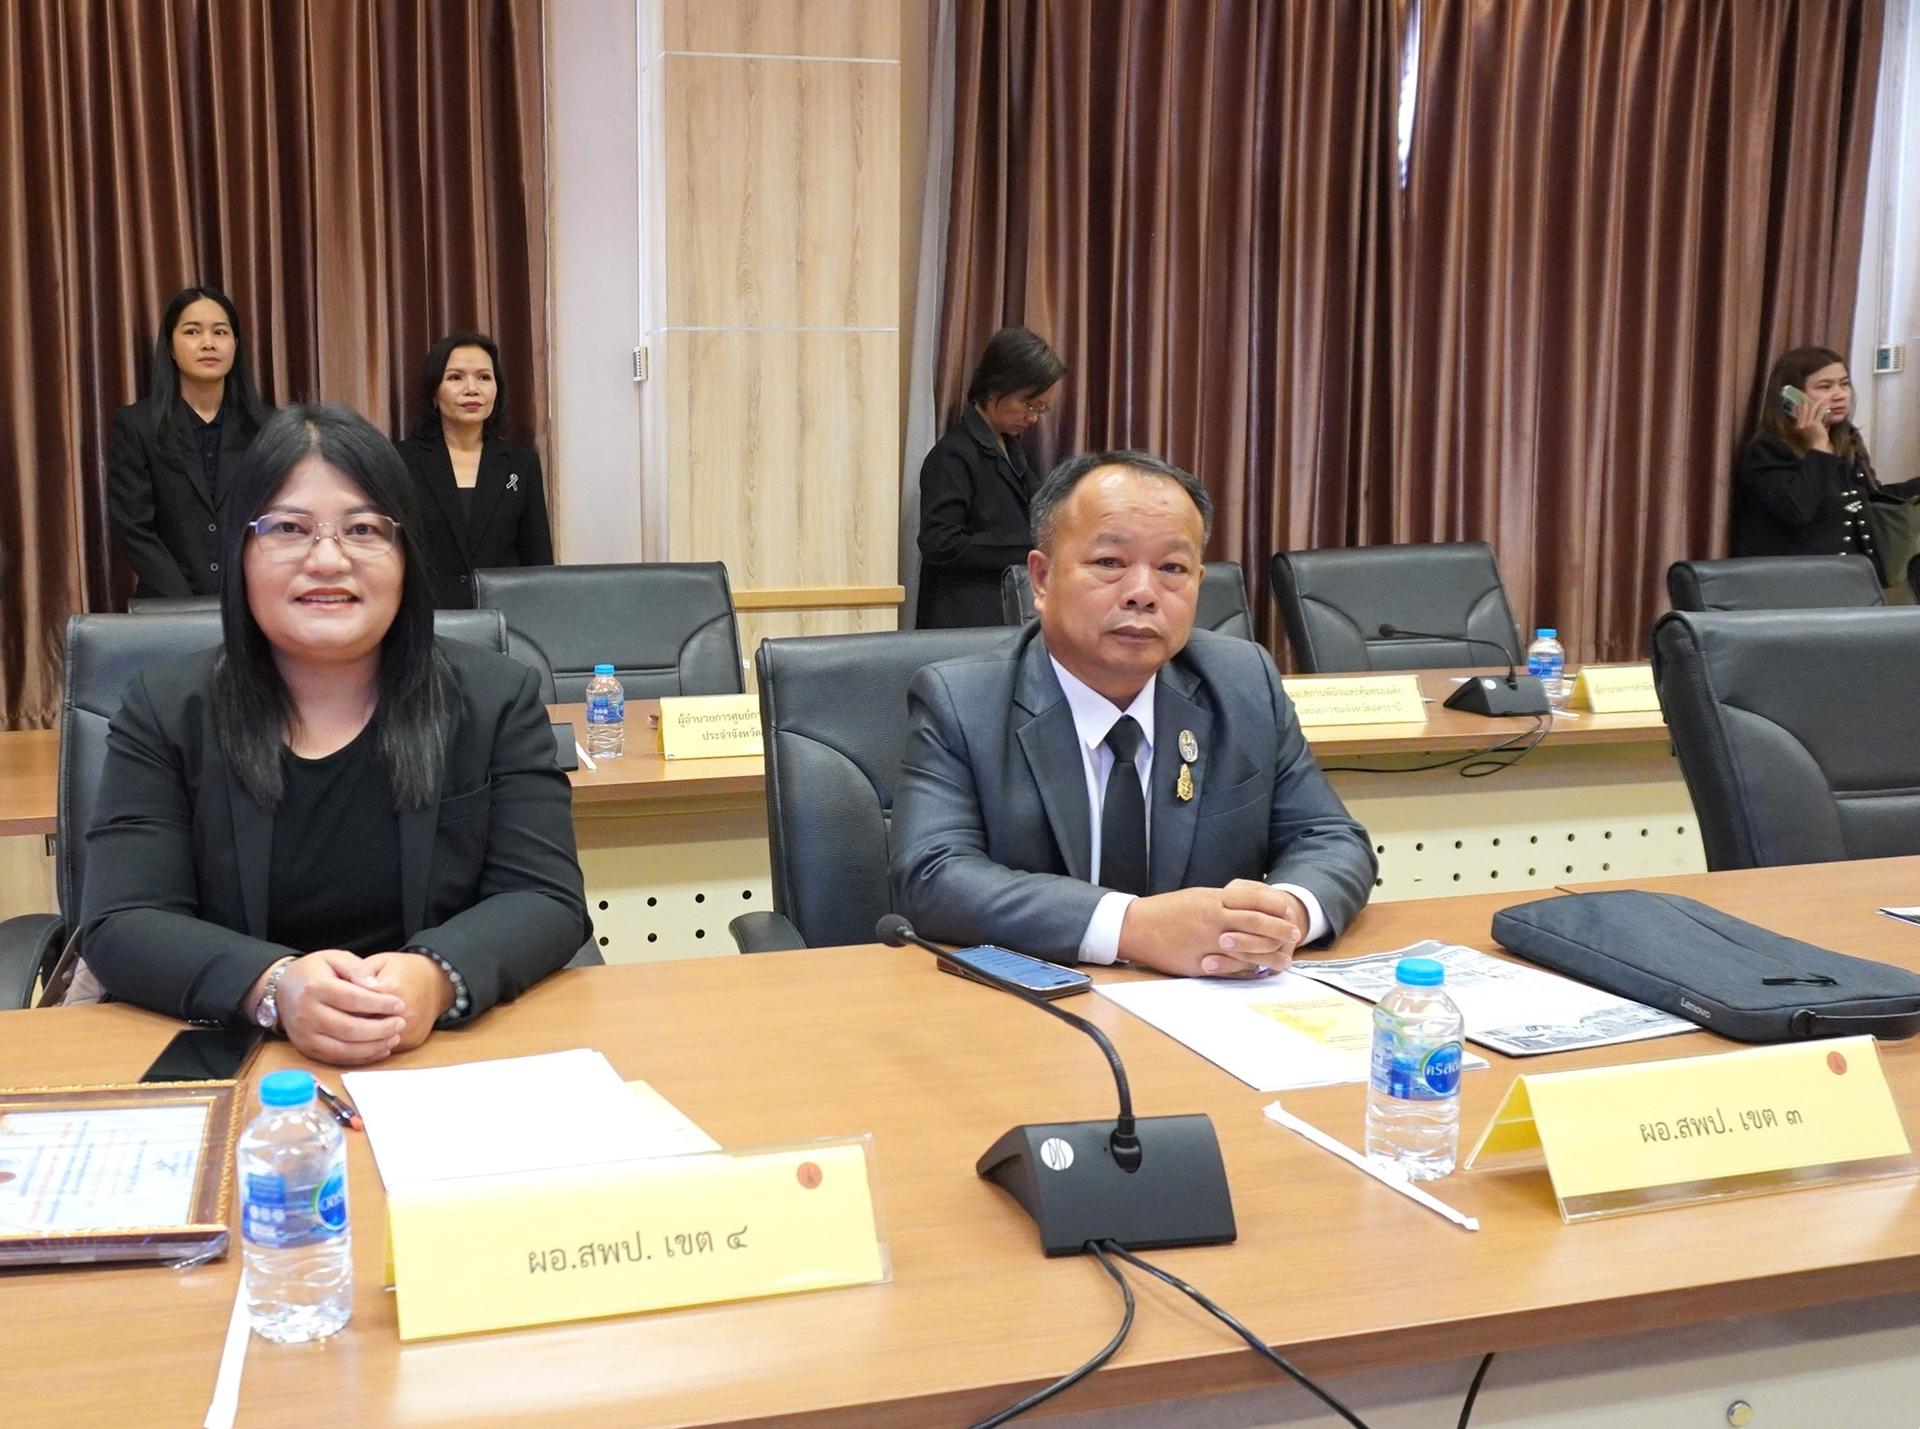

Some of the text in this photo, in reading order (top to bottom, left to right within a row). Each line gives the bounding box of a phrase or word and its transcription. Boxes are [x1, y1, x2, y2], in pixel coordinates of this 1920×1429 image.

[1680, 996, 1712, 1019] Lenovo
[1639, 1107, 1803, 1143] ผอ.สพป. เขต ๓
[528, 1225, 748, 1274] ผอ.สพป. เขต ๔
